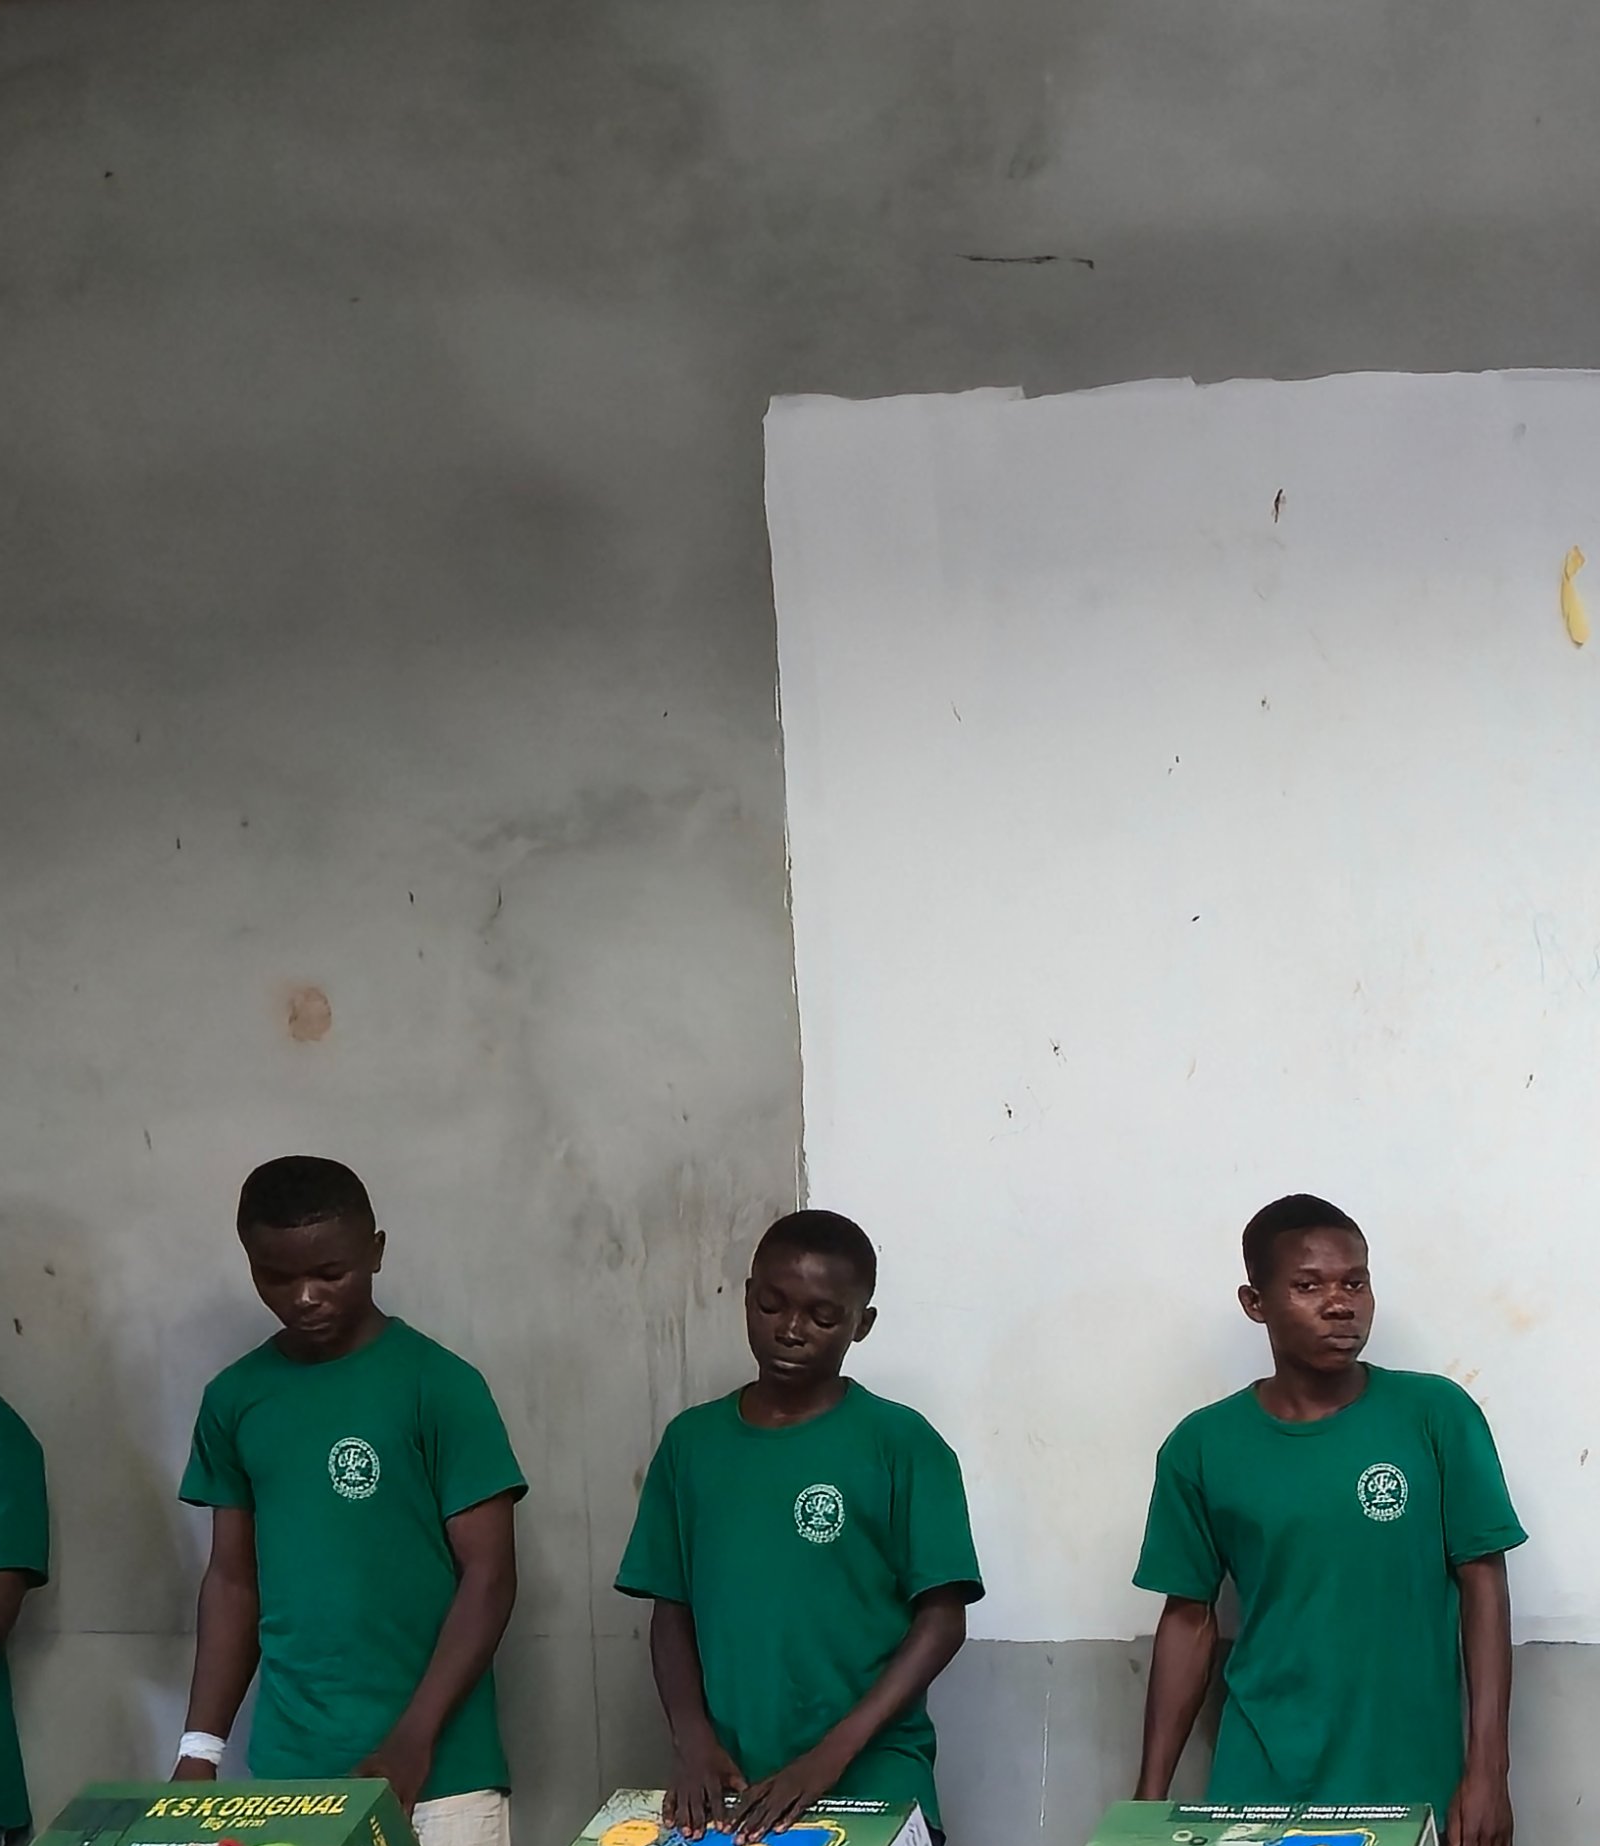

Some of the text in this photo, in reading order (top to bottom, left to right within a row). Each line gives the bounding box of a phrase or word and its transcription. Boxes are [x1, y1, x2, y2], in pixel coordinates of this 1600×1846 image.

[146, 1794, 348, 1817] K S K ORIGINAL
[200, 1817, 266, 1831] Big Farm
